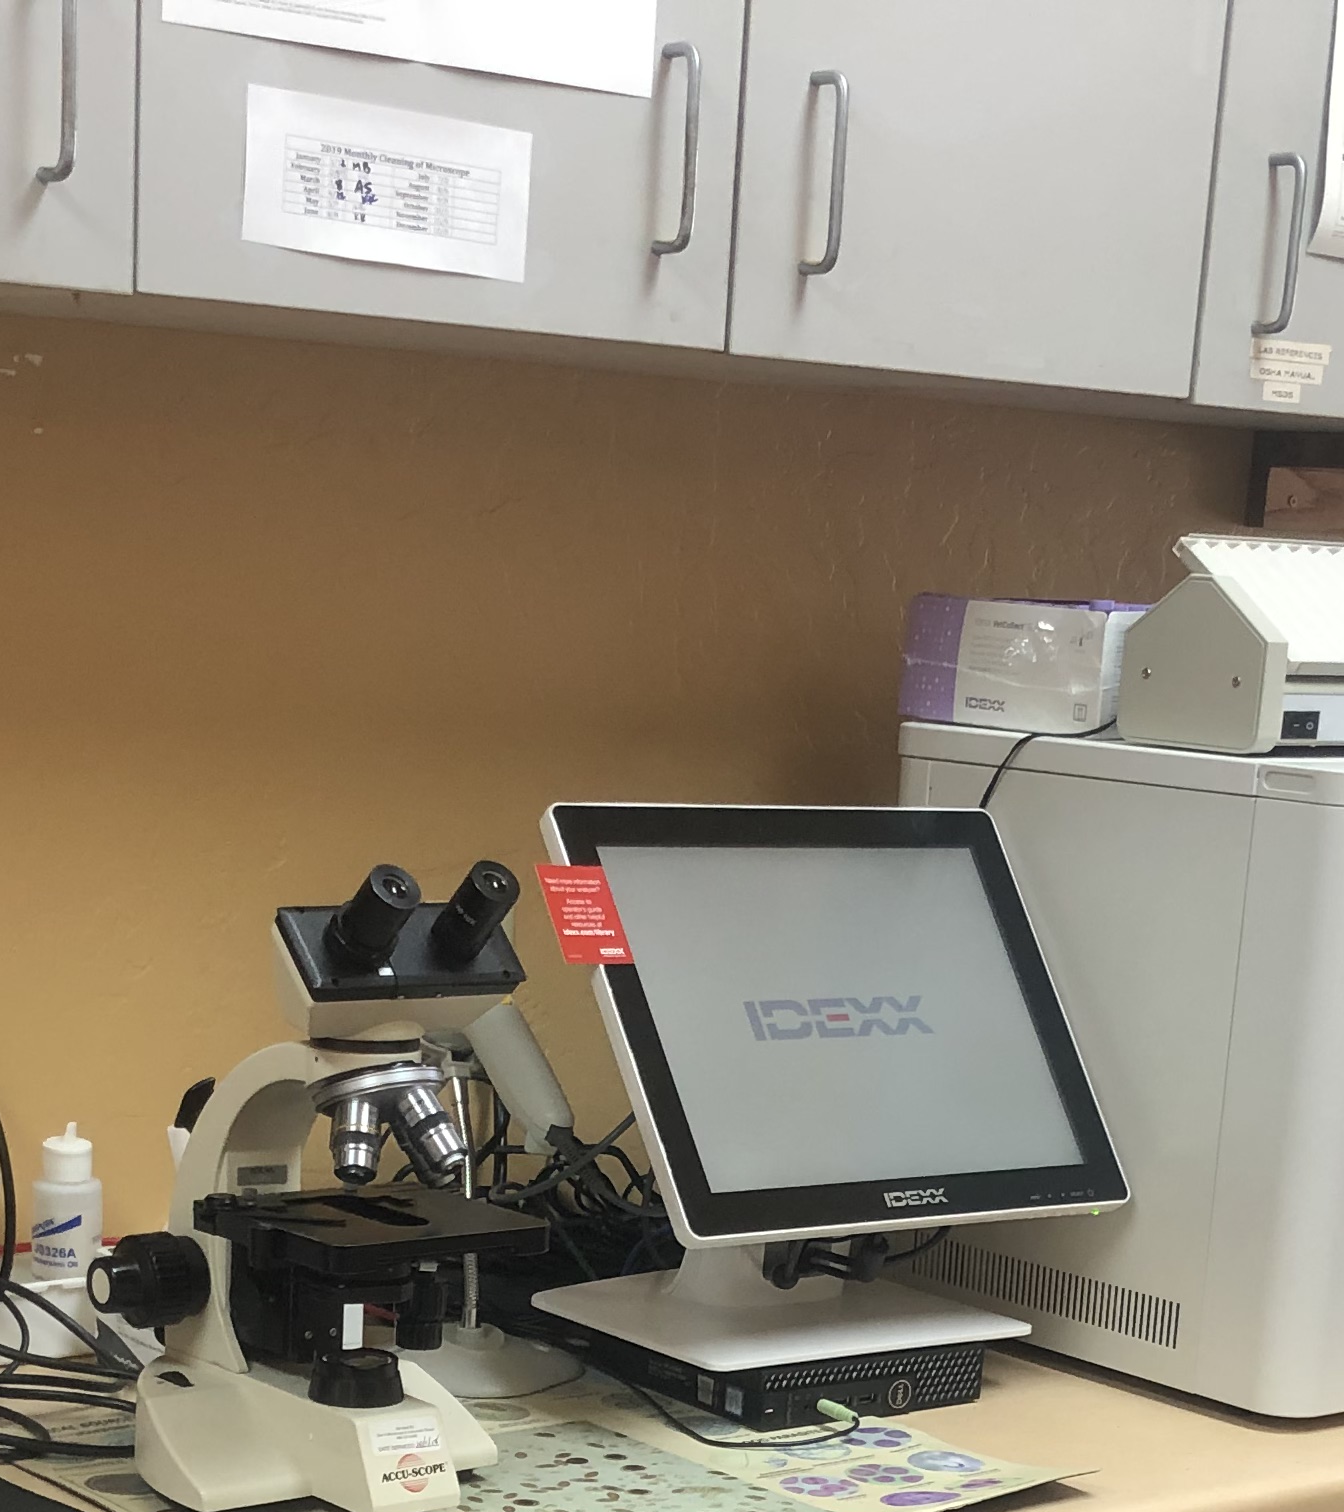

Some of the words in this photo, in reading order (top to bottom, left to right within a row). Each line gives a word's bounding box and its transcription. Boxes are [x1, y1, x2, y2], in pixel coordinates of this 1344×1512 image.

[321, 144, 342, 155] 2019
[344, 148, 377, 162] Monthly
[380, 154, 414, 170] Cleaning
[416, 160, 424, 168] of
[426, 161, 470, 178] Microscope
[965, 697, 1005, 712] IDEXX
[743, 995, 936, 1041] IDEXX
[884, 1188, 949, 1208] IDEXX
[382, 1462, 446, 1483] ACCU-SCOPE
